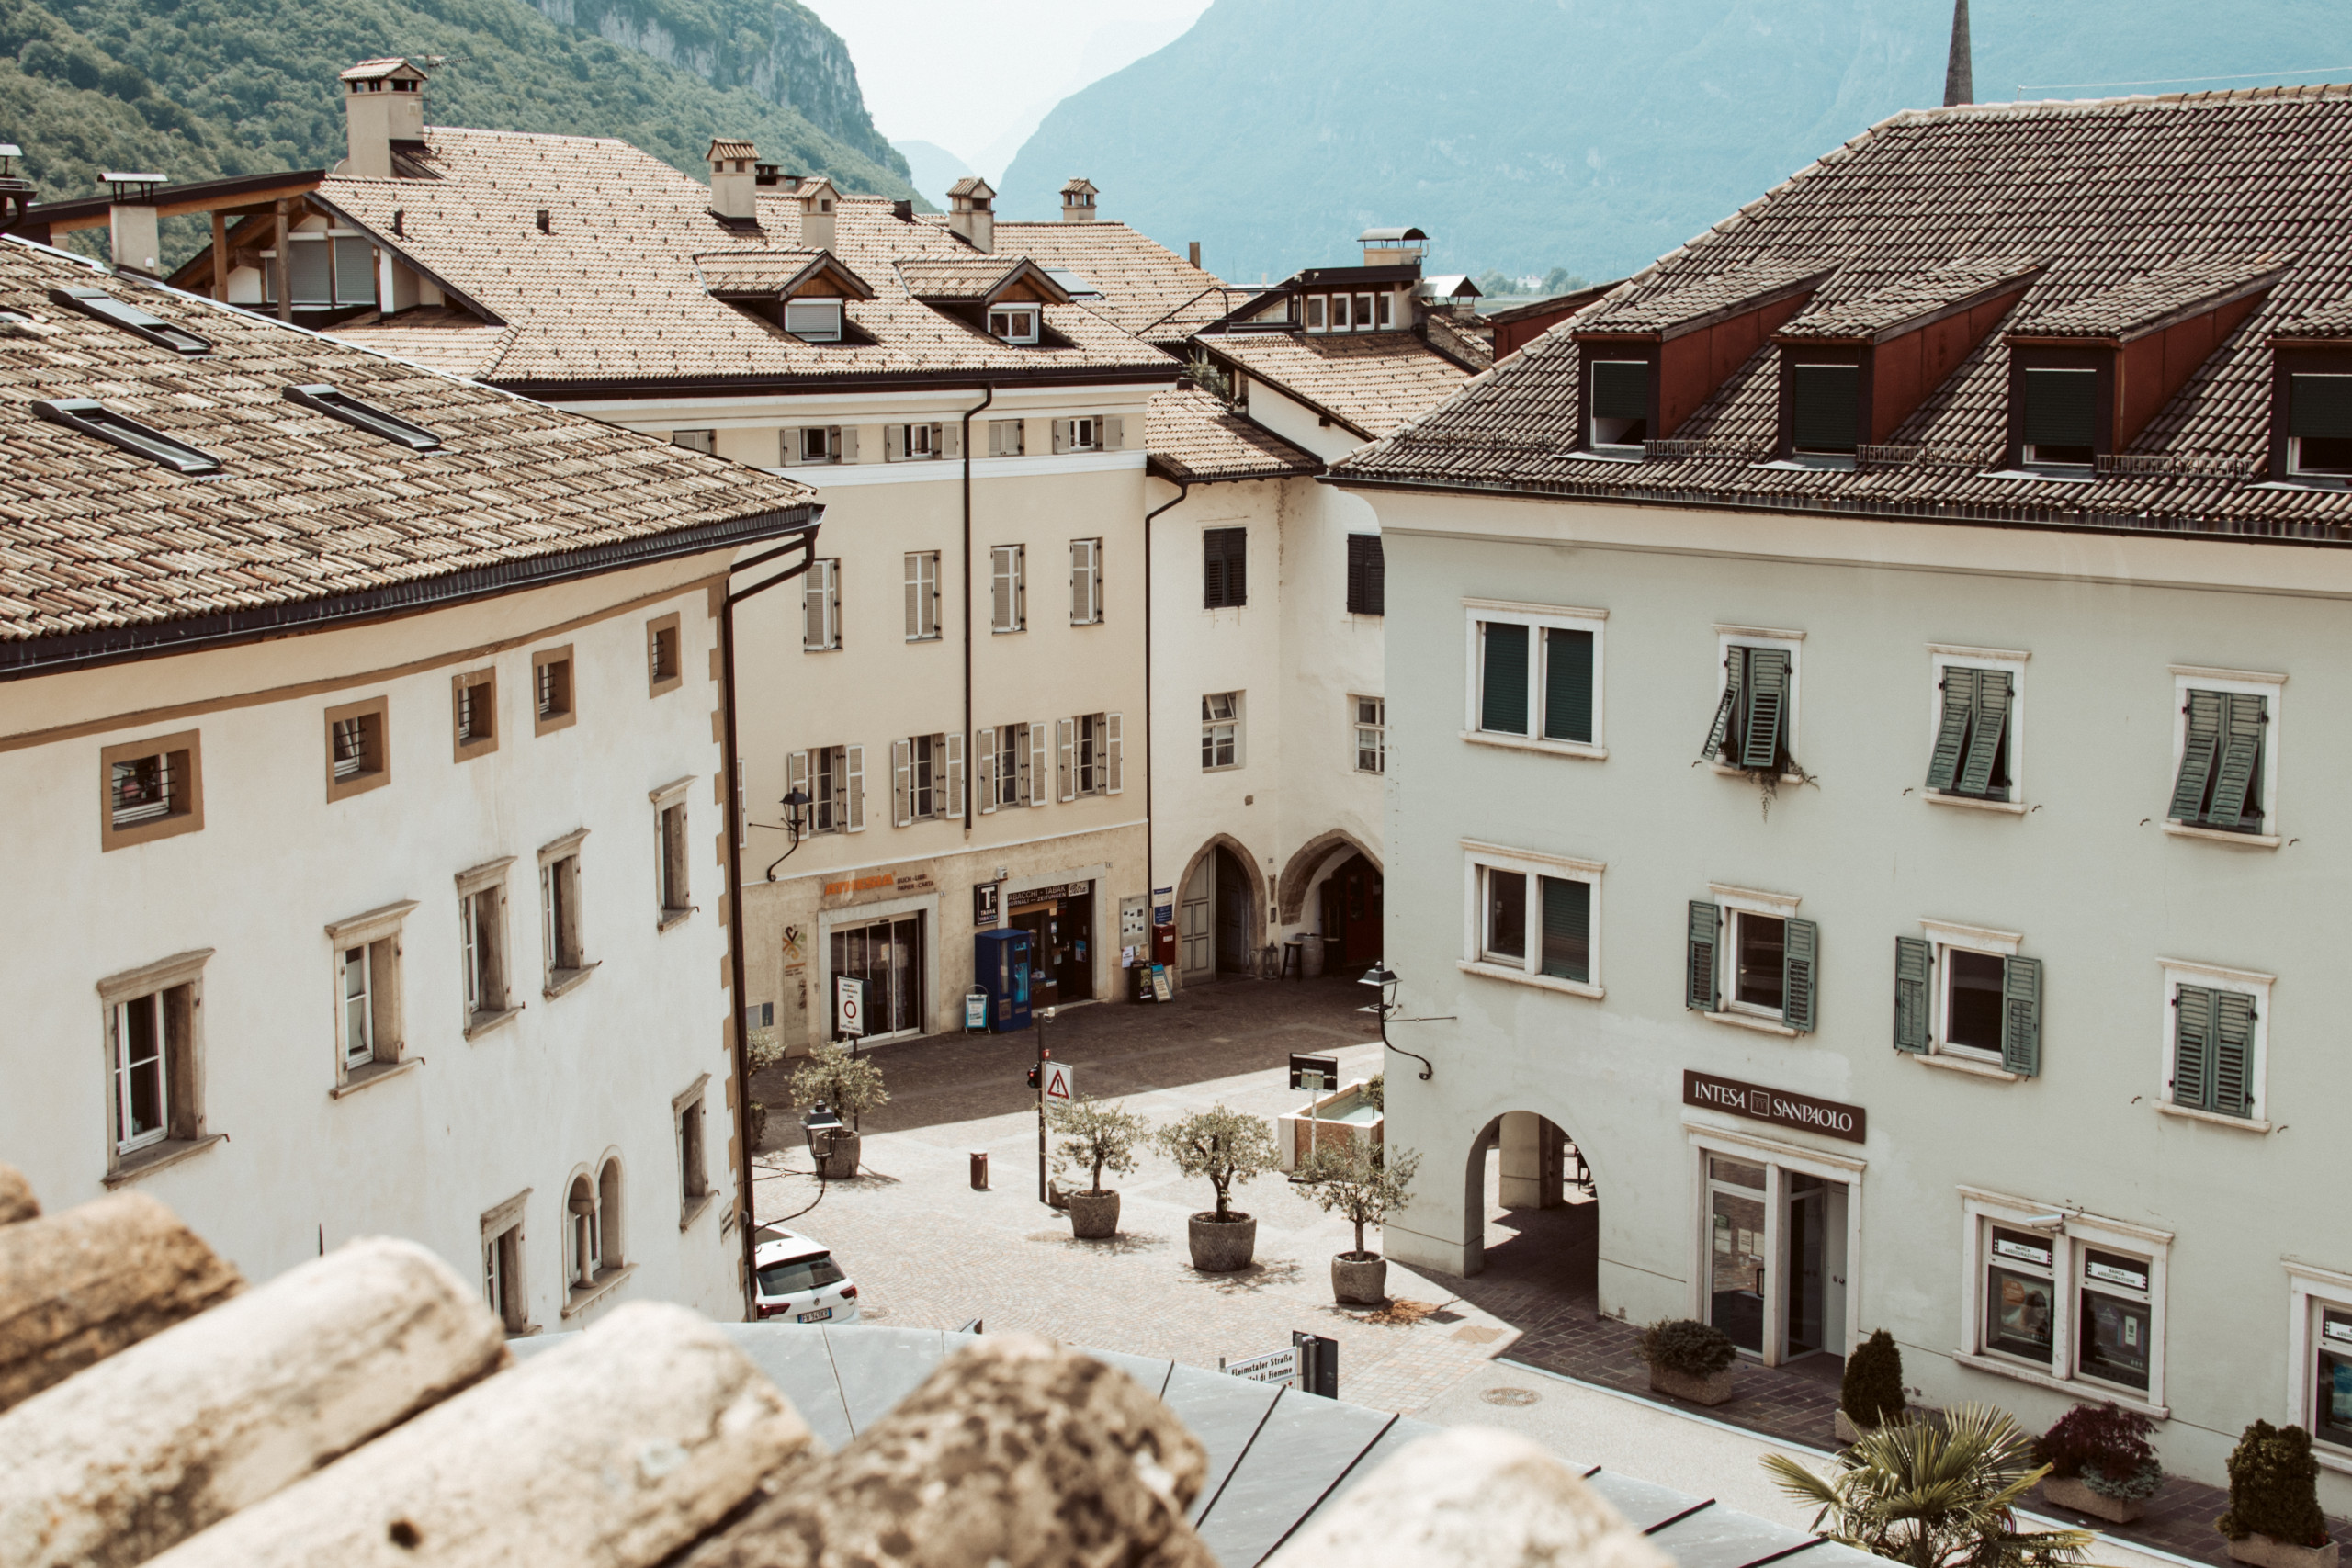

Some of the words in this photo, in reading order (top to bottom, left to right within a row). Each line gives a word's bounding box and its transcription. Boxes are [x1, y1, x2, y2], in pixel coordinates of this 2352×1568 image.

[825, 874, 894, 896] ATHESIA
[918, 880, 934, 888] CARTA
[981, 886, 995, 909] T
[1008, 890, 1038, 901] ABACCHI
[1045, 886, 1066, 896] TABAK
[1008, 898, 1030, 907] IORNALI
[1037, 892, 1067, 902] ZEITUNGEN
[979, 914, 998, 922] TABACCHI
[1694, 1080, 1746, 1109] INTESA
[1773, 1099, 1853, 1132] SANPAOLO
[2005, 1247, 2041, 1260] ASSICURAZIONE
[2098, 1271, 2135, 1284] ASSICURAZIONE
[2109, 1268, 2124, 1276] BANCA
[1231, 1361, 1269, 1376] Fleimstaler
[1270, 1354, 1293, 1367] Straße
[1260, 1372, 1266, 1382] di
[1268, 1367, 1293, 1380] Fiemme
